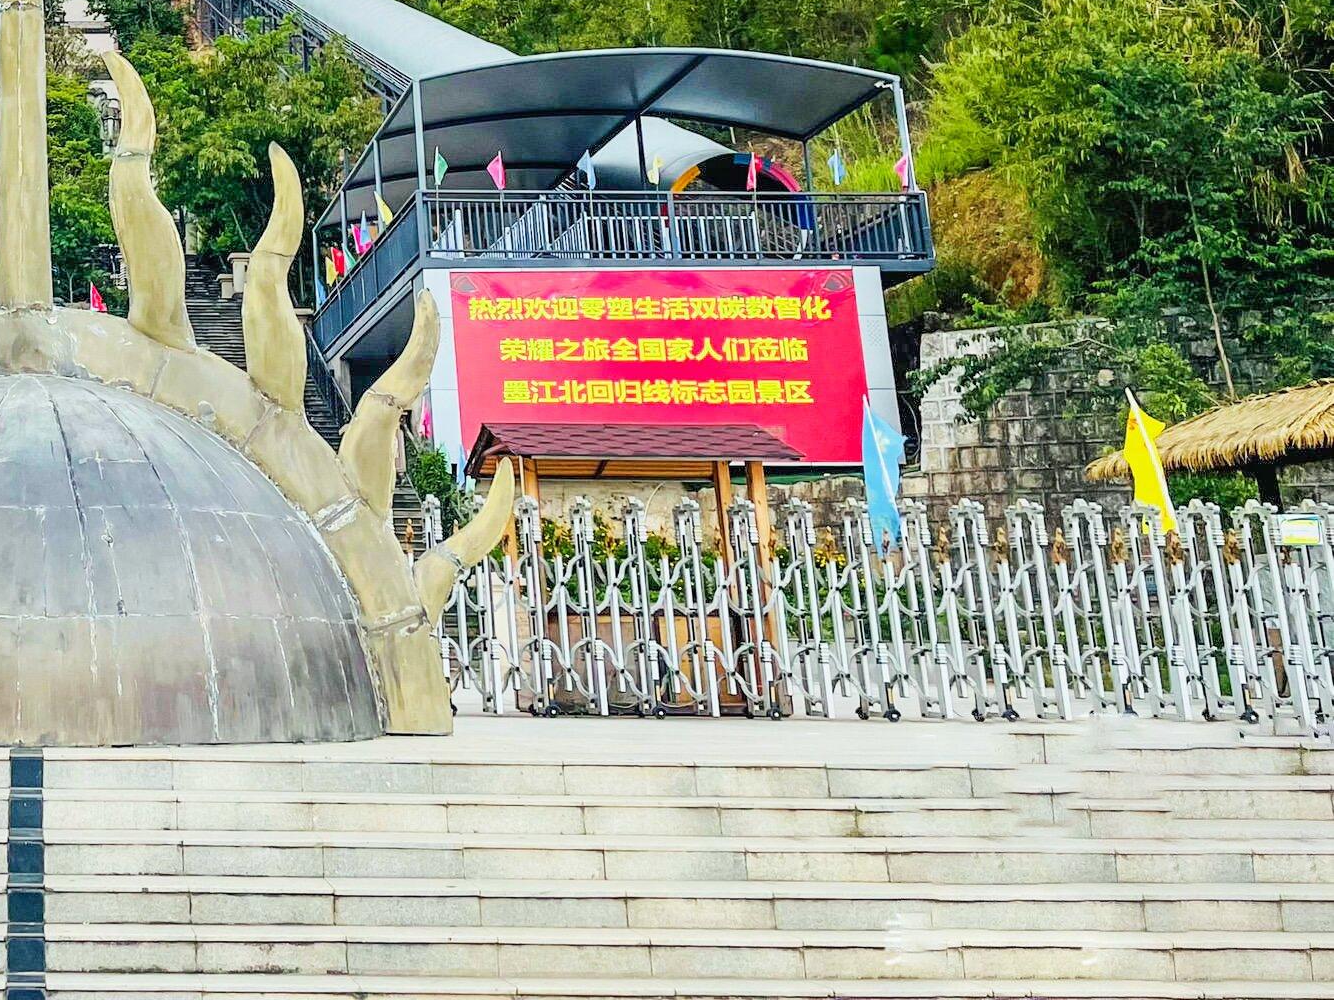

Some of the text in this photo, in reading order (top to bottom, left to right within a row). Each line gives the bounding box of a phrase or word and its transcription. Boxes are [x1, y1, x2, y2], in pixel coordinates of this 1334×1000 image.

[468, 295, 832, 321] 热烈欢迎零塑生活双碳数智化
[499, 337, 809, 362] 荣耀之旅全国家人们莅临
[502, 379, 815, 405] 墨江北回归线标志园景区
